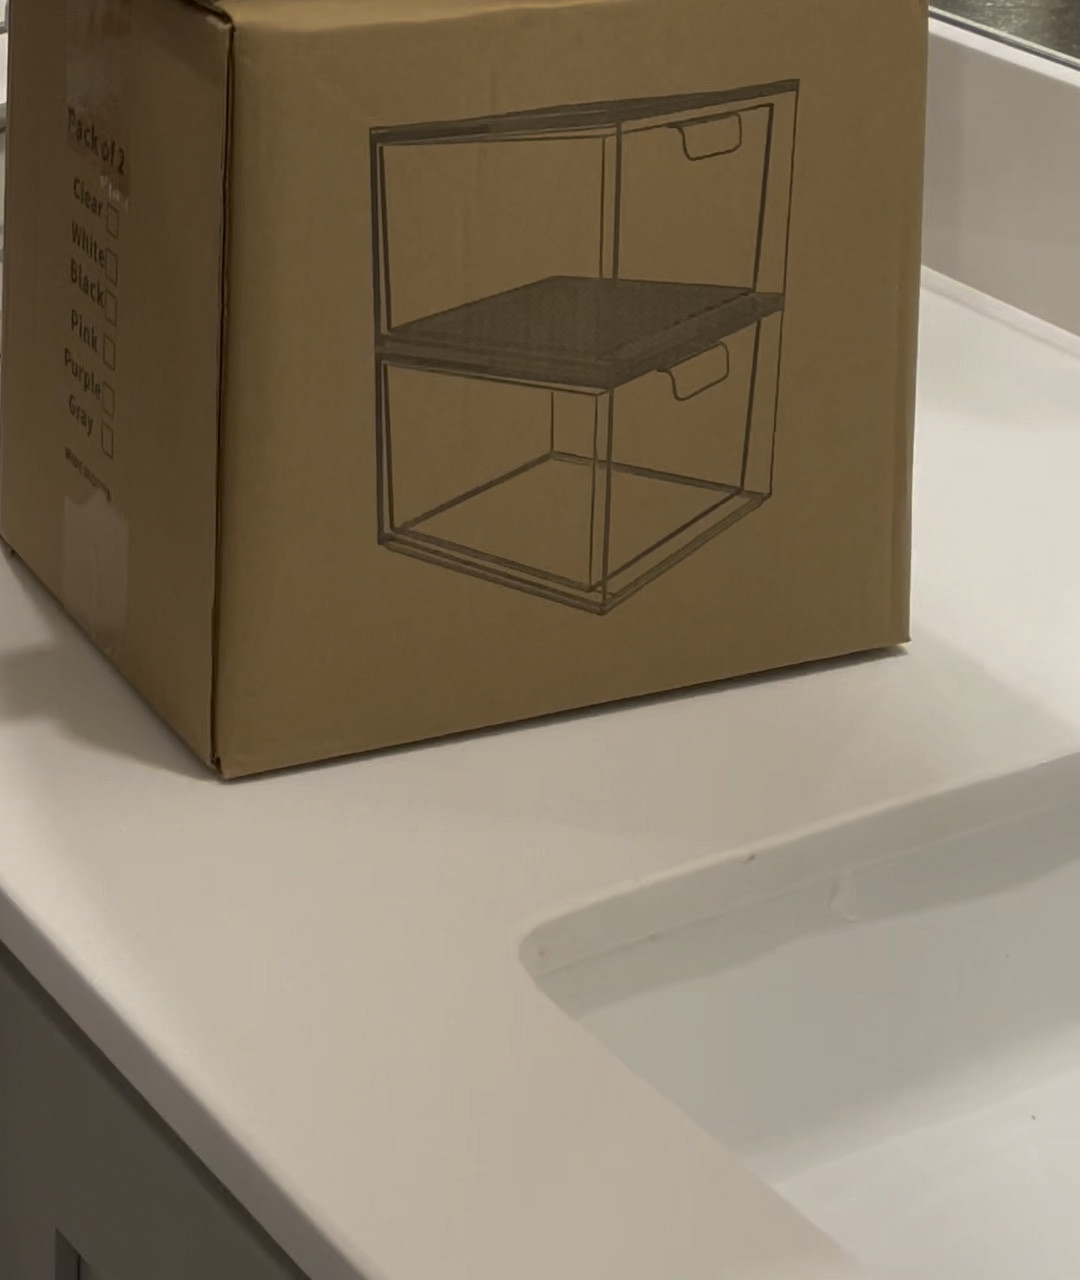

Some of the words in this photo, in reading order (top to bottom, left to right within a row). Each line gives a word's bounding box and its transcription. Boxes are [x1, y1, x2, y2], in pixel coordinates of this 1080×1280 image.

[67, 106, 99, 158] Pack
[100, 139, 116, 167] of
[116, 147, 126, 176] 2
[73, 176, 103, 217] Clear
[72, 218, 105, 269] White
[70, 257, 105, 309] Black
[71, 308, 98, 353] Pink
[64, 347, 101, 401] Purple
[68, 393, 94, 438] Gray
